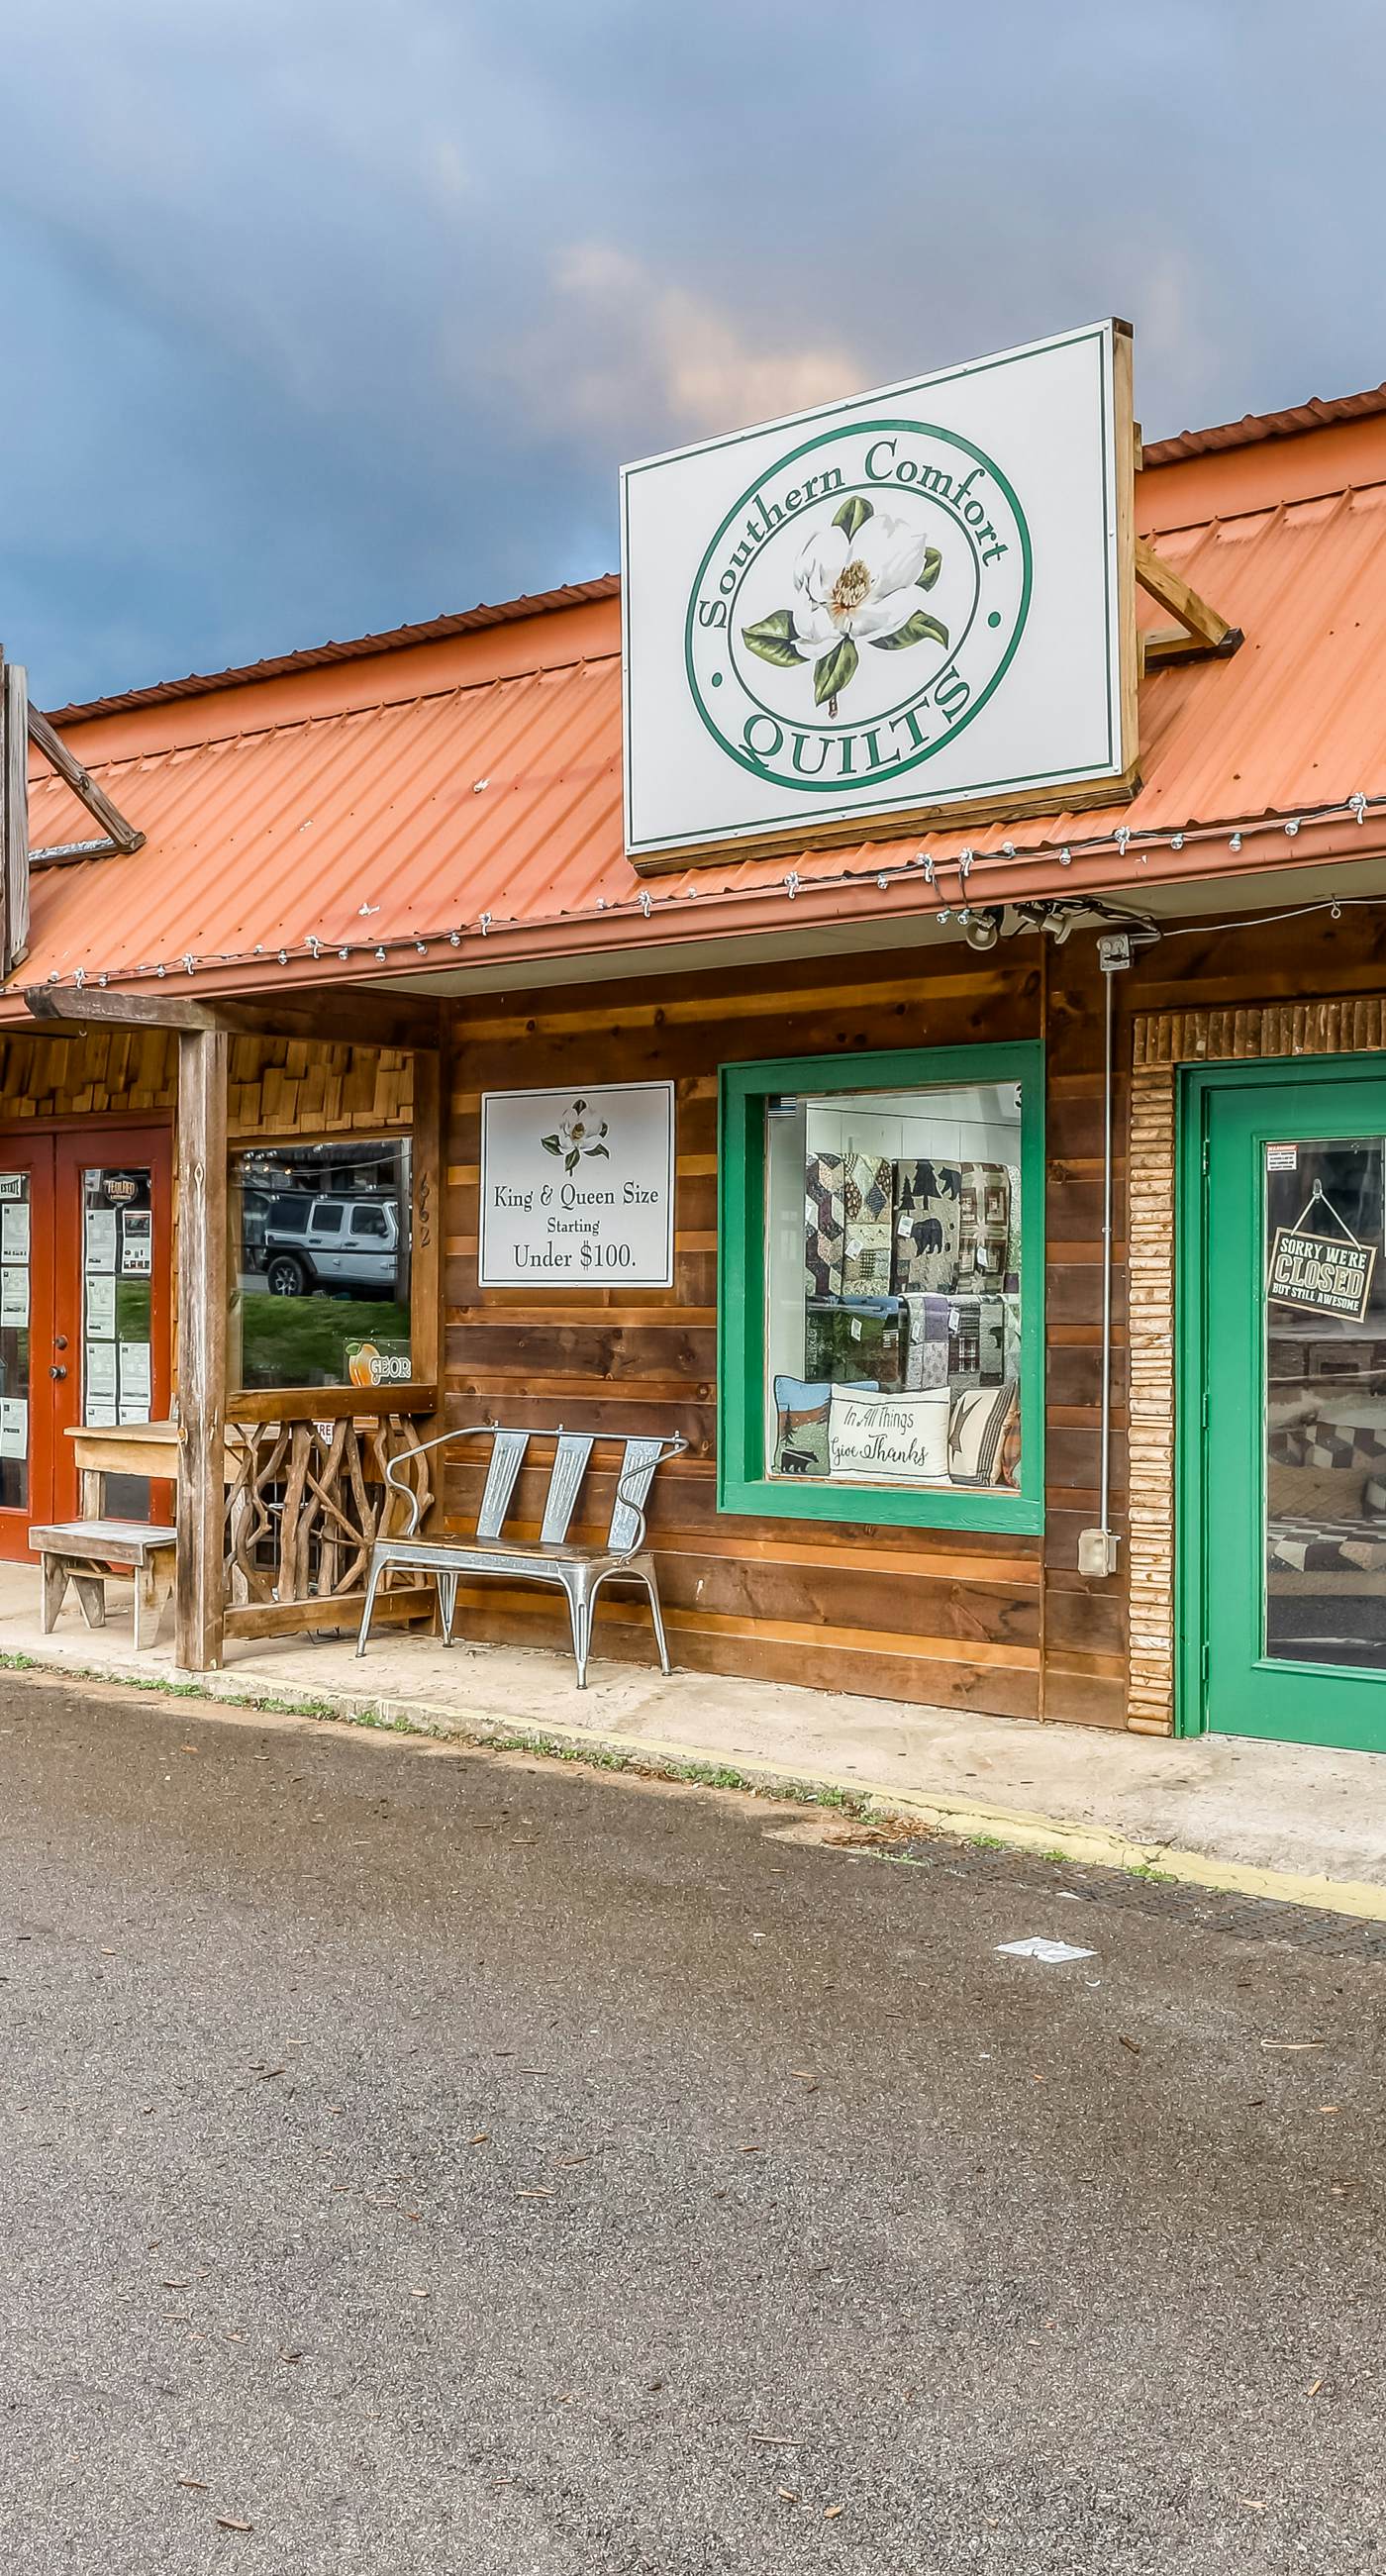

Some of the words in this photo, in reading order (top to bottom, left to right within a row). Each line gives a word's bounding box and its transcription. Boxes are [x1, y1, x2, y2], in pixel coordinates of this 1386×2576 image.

[699, 464, 845, 629] Southern
[864, 439, 1008, 567] Comfort
[739, 664, 971, 776] QUILTS
[494, 1185, 534, 1212] King
[540, 1184, 553, 1207] &
[560, 1183, 615, 1211] Queen
[623, 1180, 659, 1205] Size
[546, 1217, 600, 1237] Starting
[513, 1240, 573, 1267] Under
[580, 1239, 637, 1271] $100.
[1280, 1238, 1324, 1260] SORRY
[1274, 1253, 1365, 1299] CLOSED
[1272, 1282, 1291, 1297] BUT
[1291, 1287, 1316, 1302] STILL
[1317, 1293, 1359, 1312] AWESOME
[369, 1356, 411, 1386] GEOR
[843, 1406, 857, 1427] In
[856, 1408, 879, 1427] All
[879, 1407, 915, 1435] Things
[831, 1437, 859, 1466] Give
[859, 1434, 929, 1466] Thanks
